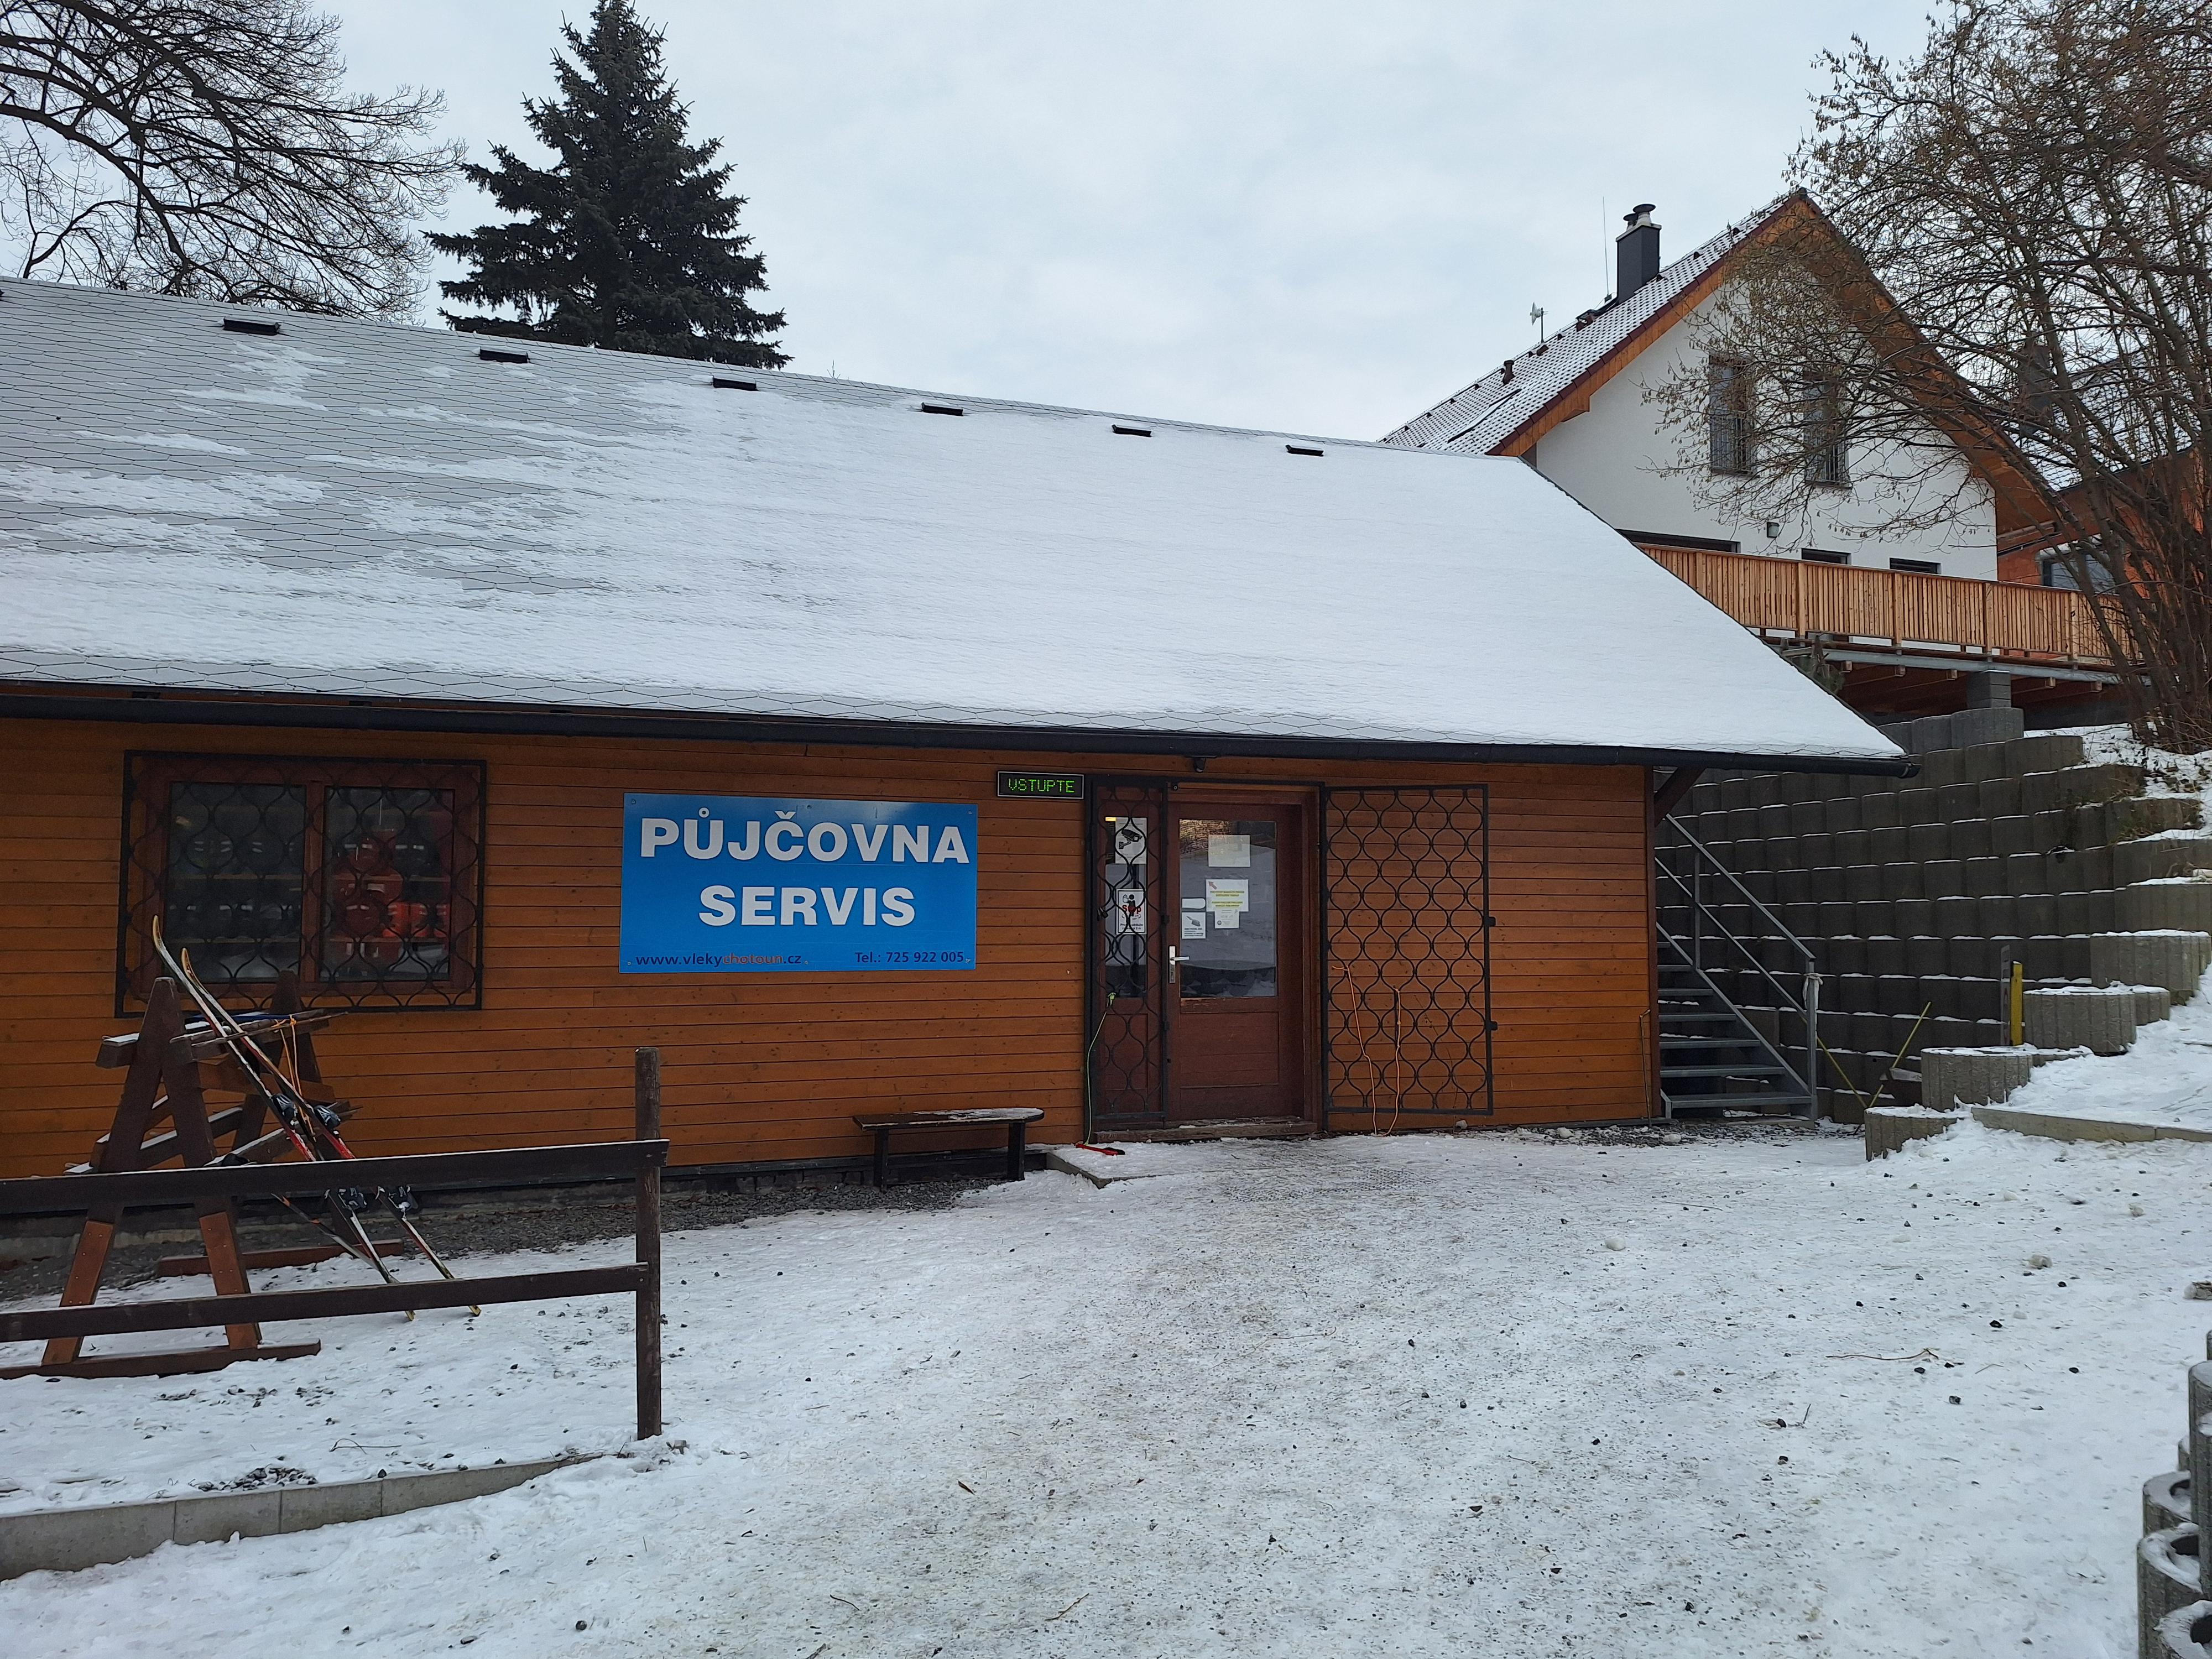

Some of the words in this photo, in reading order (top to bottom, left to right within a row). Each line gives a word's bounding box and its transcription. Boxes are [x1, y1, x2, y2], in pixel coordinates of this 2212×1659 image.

[1008, 778, 1074, 792] VSTUPTE
[640, 807, 970, 864] PŮJČOVNA
[698, 885, 915, 926] SERVIS
[636, 952, 802, 968] www.vlekychotoun.cz
[854, 951, 881, 963] Tel.:
[886, 952, 909, 963] 725
[914, 951, 937, 962] 922
[941, 951, 964, 962] 005
